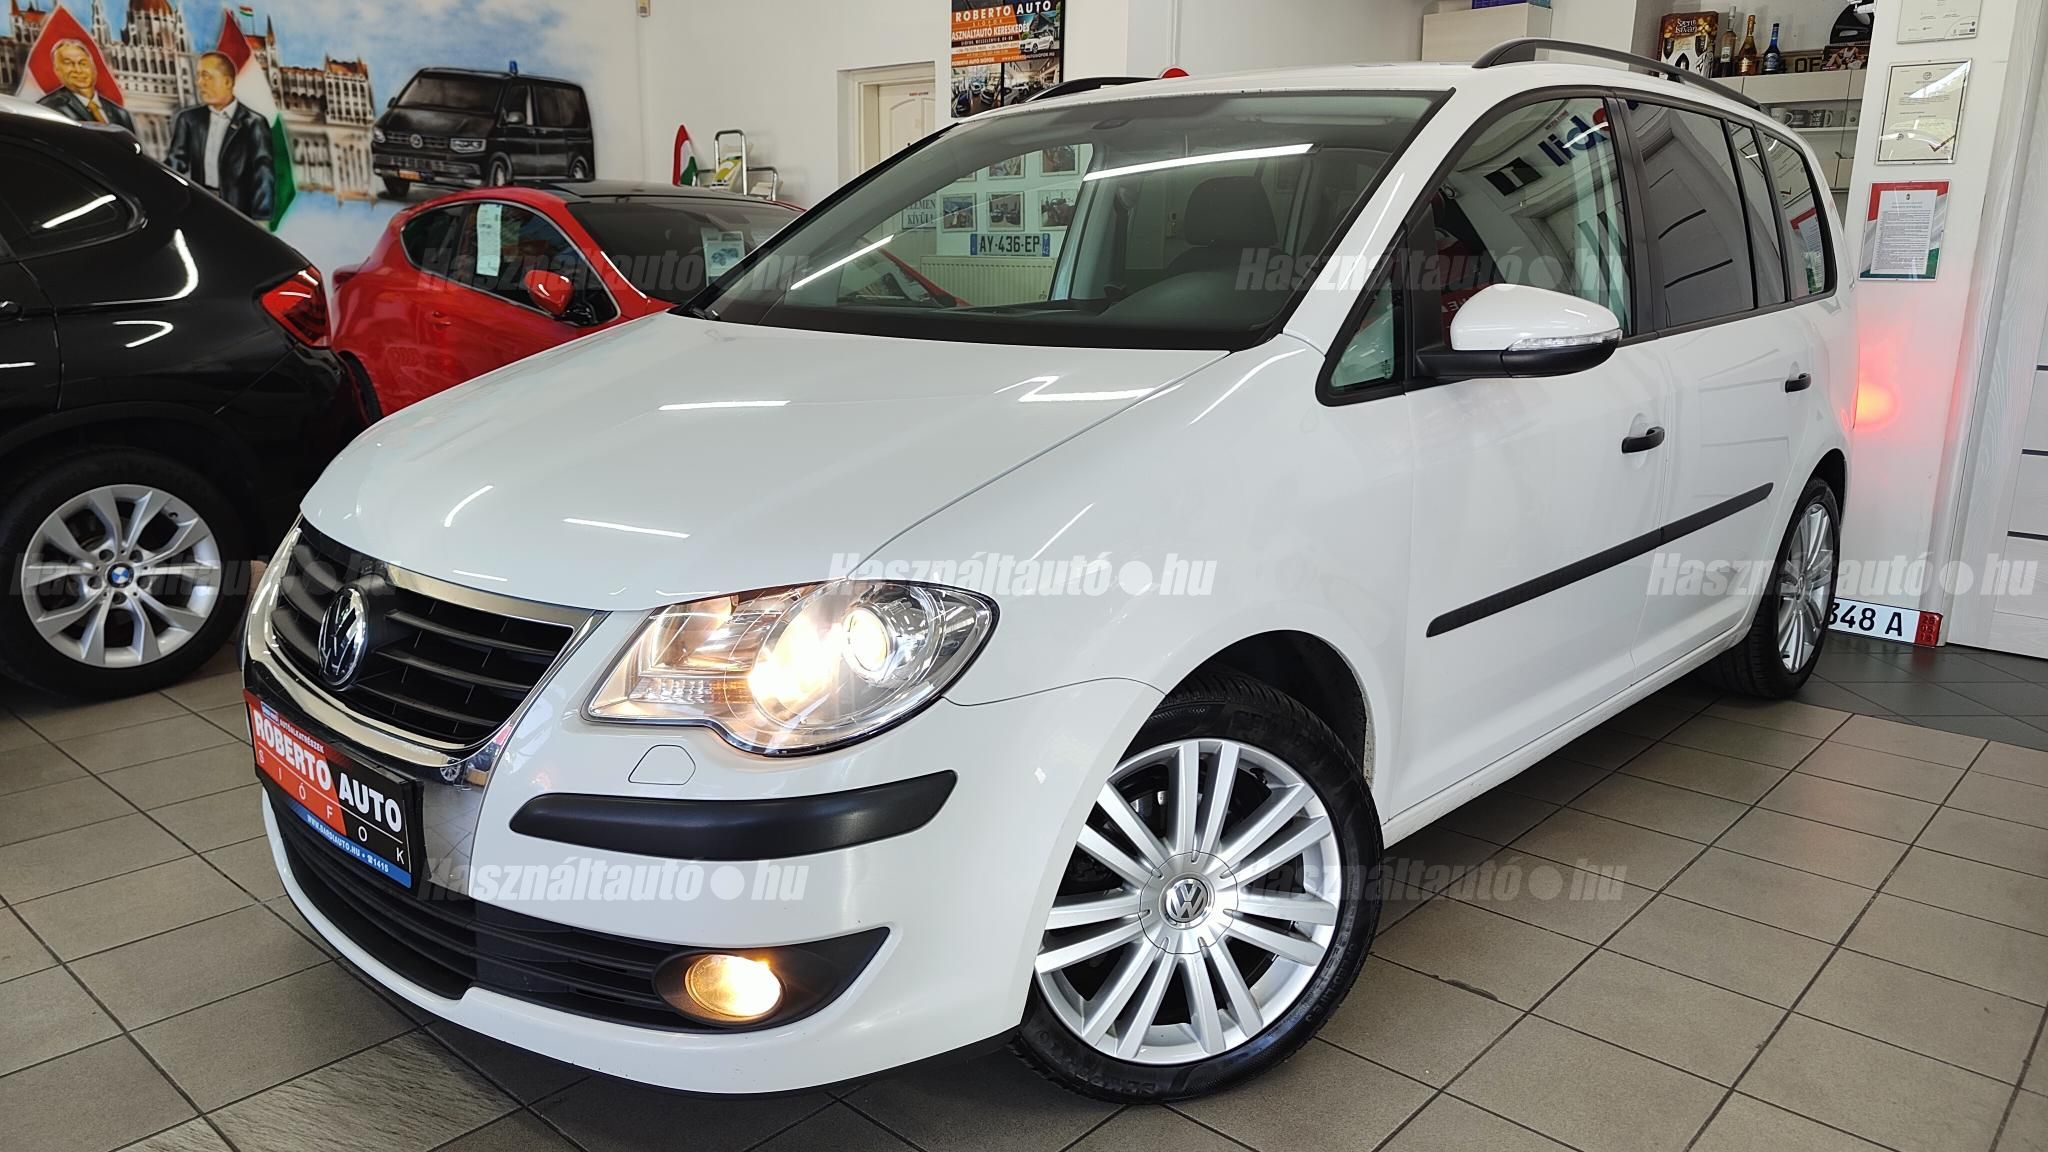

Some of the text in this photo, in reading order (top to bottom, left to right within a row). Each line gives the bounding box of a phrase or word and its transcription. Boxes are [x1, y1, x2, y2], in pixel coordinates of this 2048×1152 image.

[955, 0, 1051, 22] ROBERTO AUTO
[1884, 611, 1903, 637] A
[253, 709, 403, 833] ROBERTO AUTO
